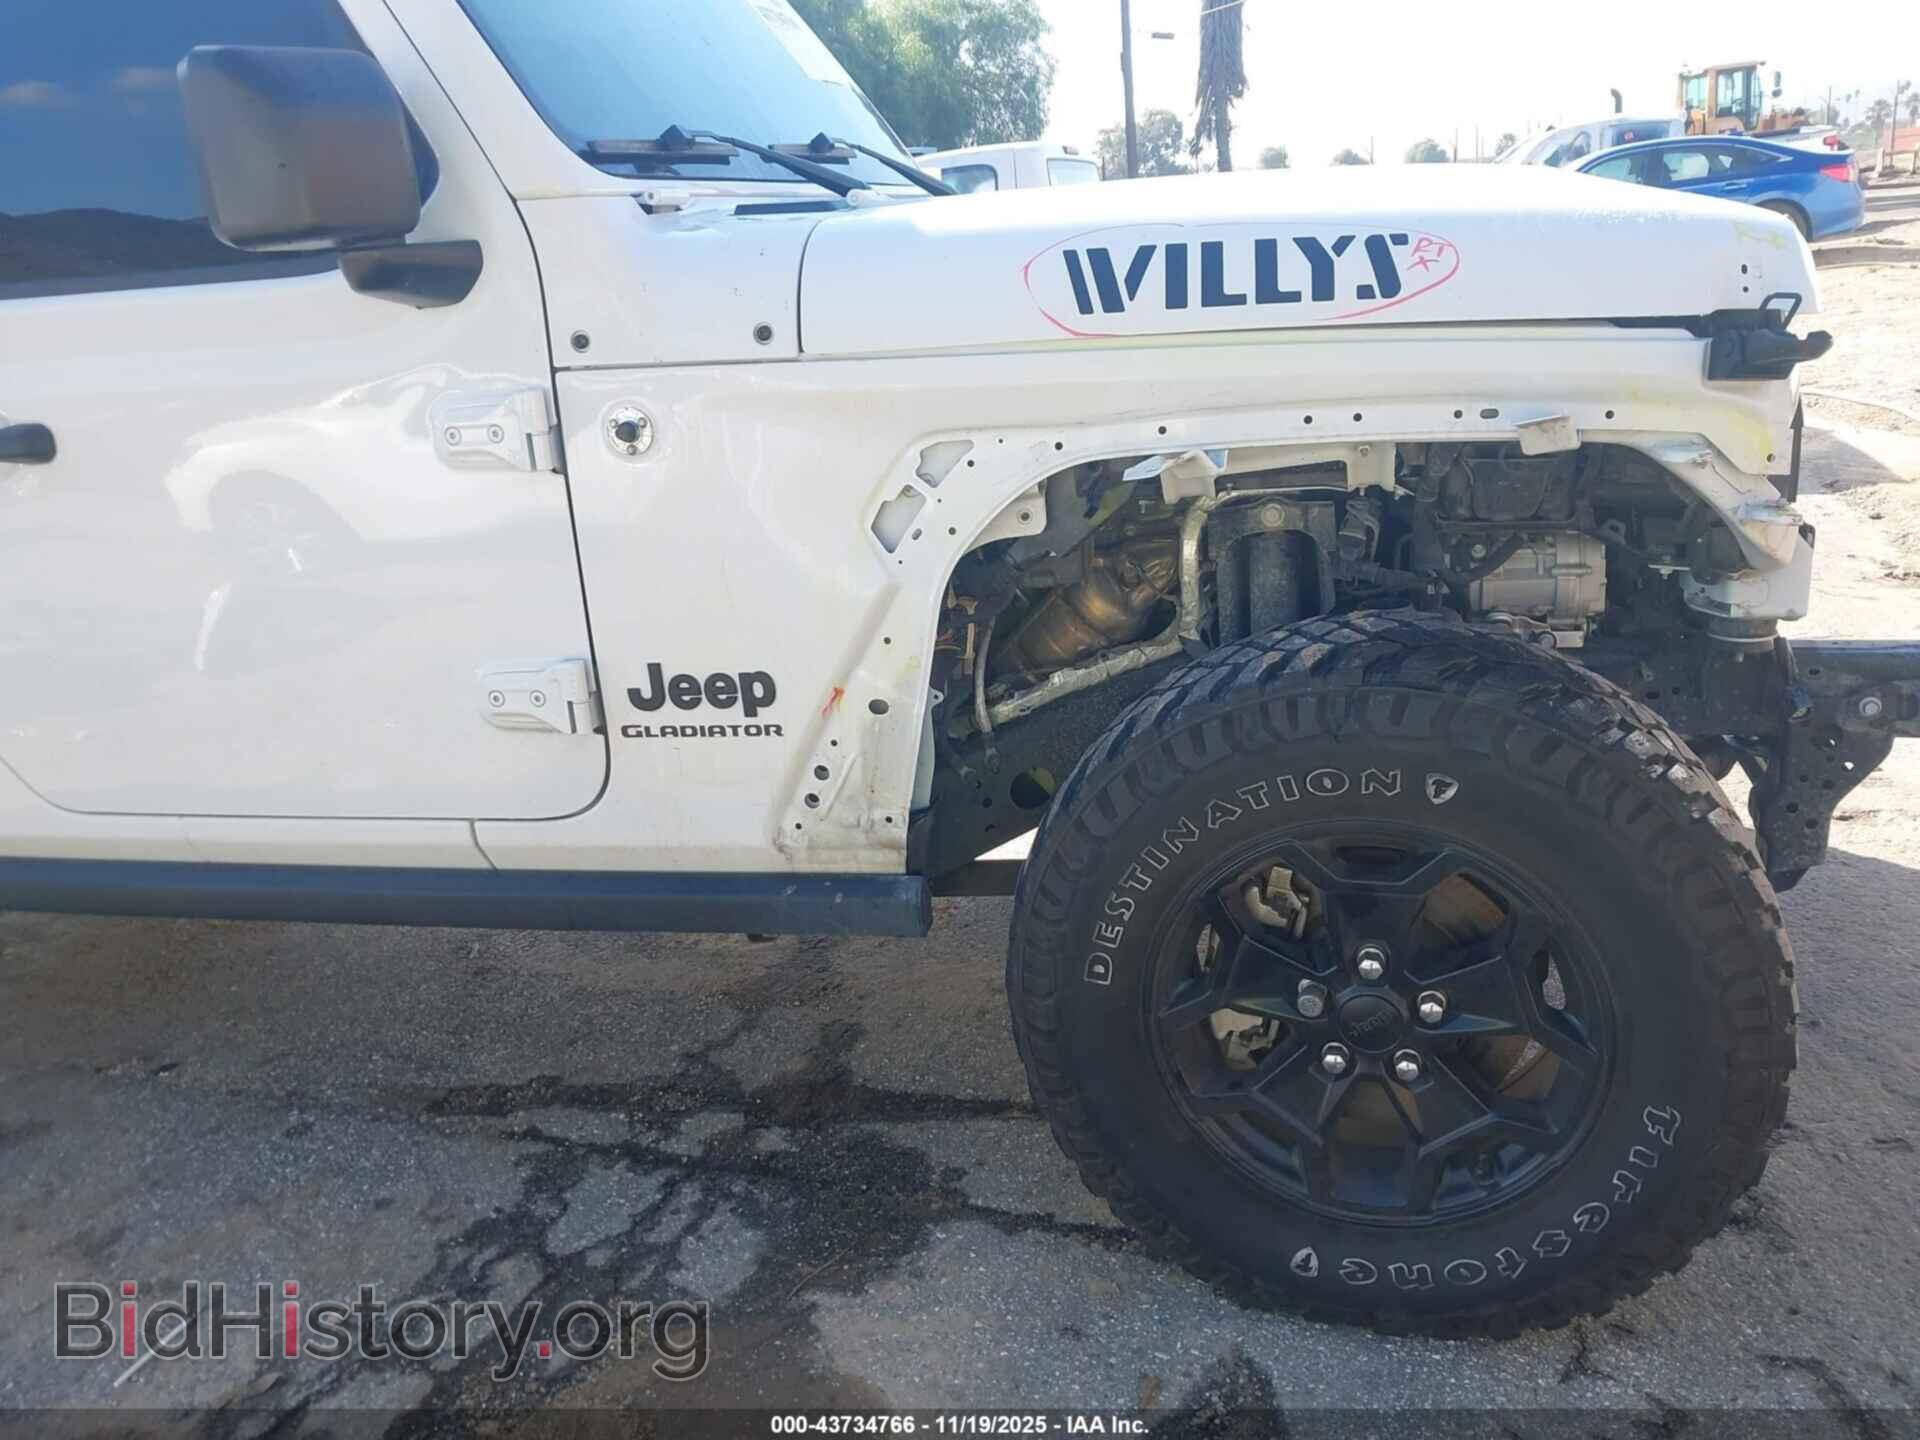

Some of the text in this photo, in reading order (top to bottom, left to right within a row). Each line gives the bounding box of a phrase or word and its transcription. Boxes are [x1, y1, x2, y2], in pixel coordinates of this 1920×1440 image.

[1062, 232, 1409, 315] WILLYS
[621, 724, 784, 738] GLADIATOR
[626, 662, 777, 718] Jeep
[1083, 768, 1402, 986] DESTINATION
[1338, 1105, 1681, 1290] Firestone
